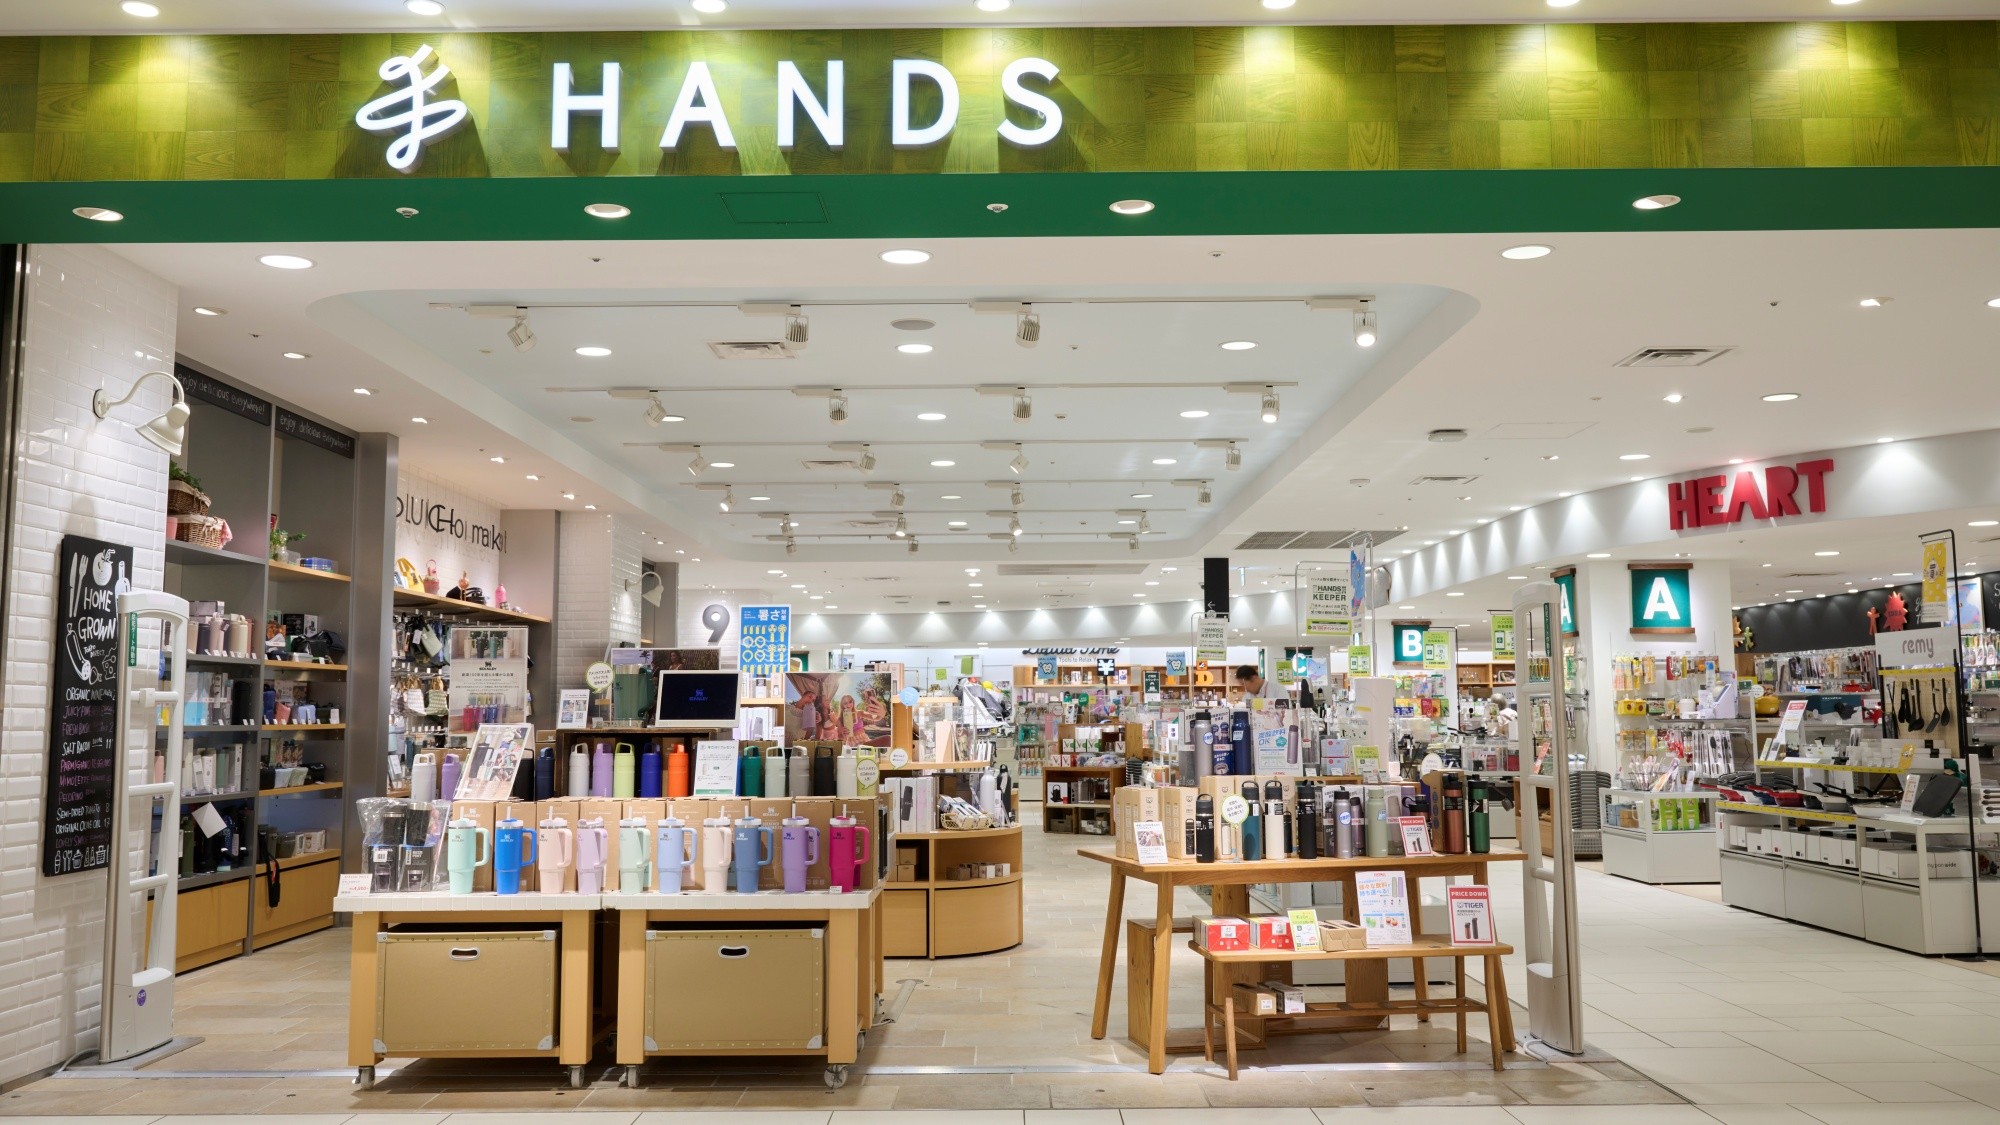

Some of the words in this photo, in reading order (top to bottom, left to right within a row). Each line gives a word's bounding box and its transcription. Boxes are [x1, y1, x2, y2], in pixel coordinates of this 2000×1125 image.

[551, 57, 1063, 151] HANDS
[177, 372, 198, 392] enjoy
[199, 380, 231, 401] delicious
[280, 414, 297, 433] enjoy
[1668, 458, 1834, 530] HEART
[83, 587, 113, 613] HOME
[1312, 593, 1347, 601] KEEPER
[1643, 577, 1681, 620] A
[77, 616, 117, 642] GROWN
[702, 604, 731, 647] 9
[1402, 629, 1423, 657] B
[1902, 638, 1934, 658] remy
